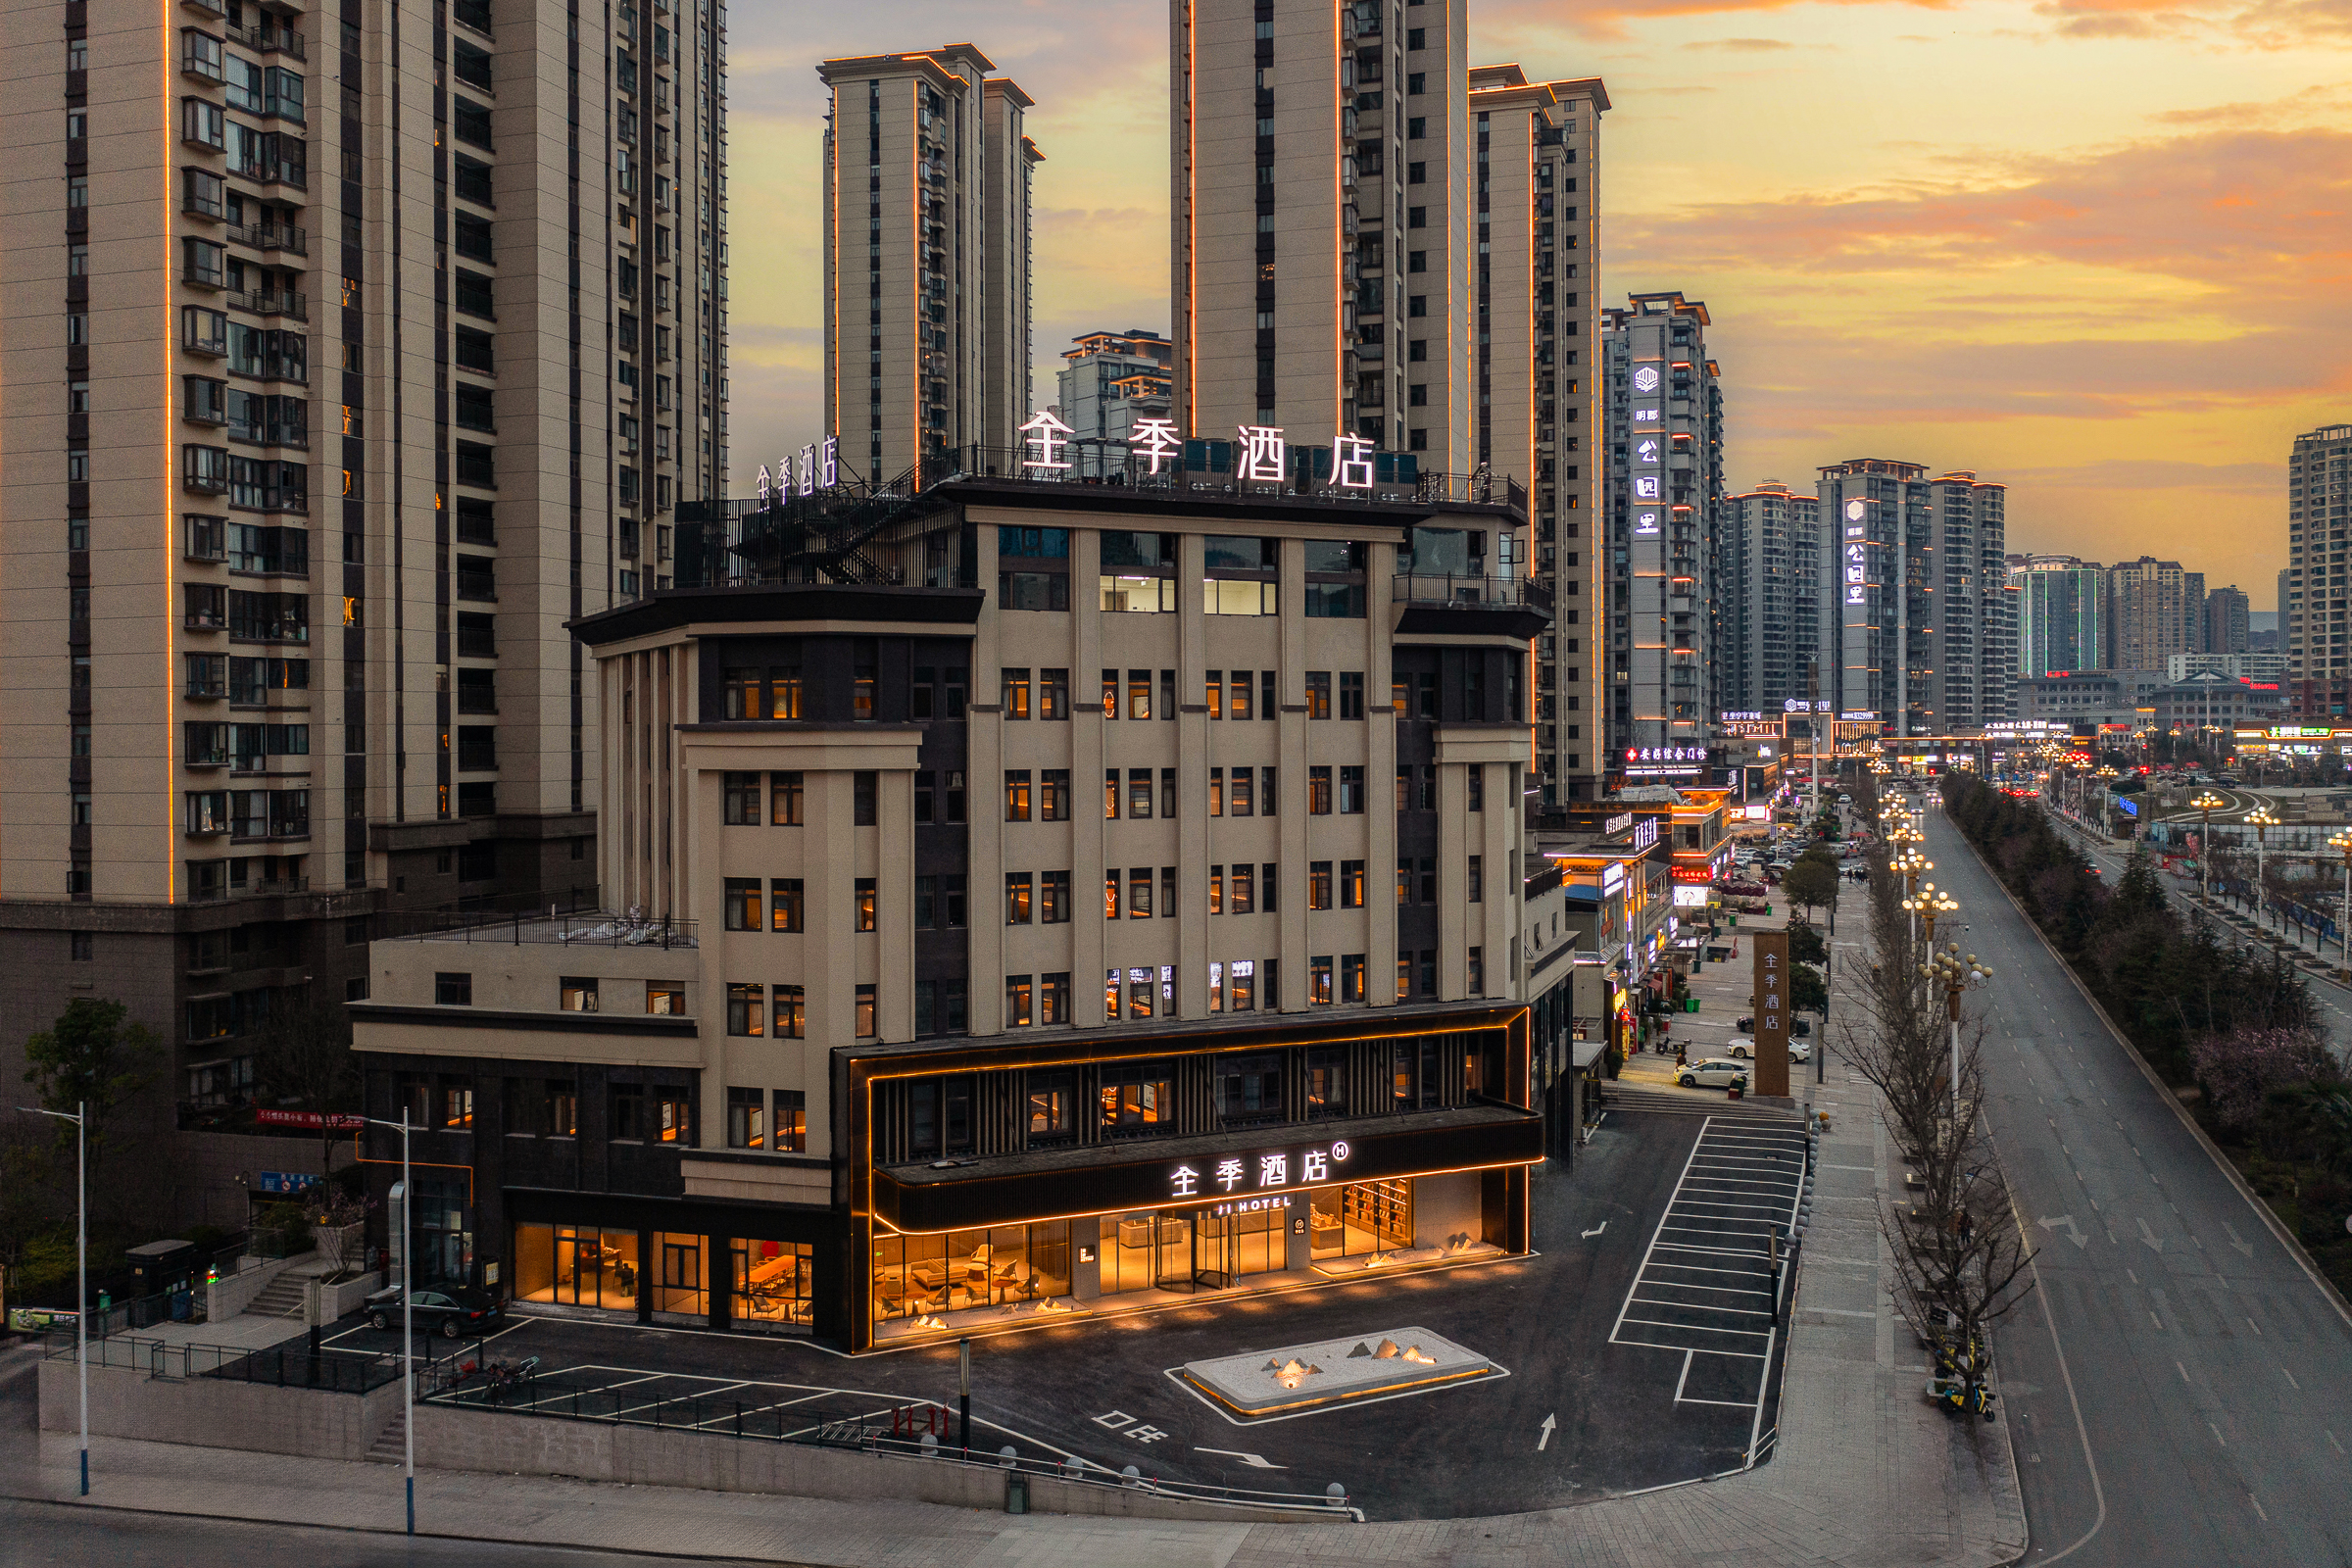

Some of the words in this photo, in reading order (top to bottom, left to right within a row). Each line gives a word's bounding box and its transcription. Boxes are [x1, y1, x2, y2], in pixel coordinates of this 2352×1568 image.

[756, 434, 836, 510] 全季酒店
[1017, 411, 1375, 489] 全季酒店
[1764, 953, 1779, 1030] 全季酒店
[1170, 1150, 1328, 1198] 全季酒店
[1239, 1197, 1292, 1212] HOTEL
